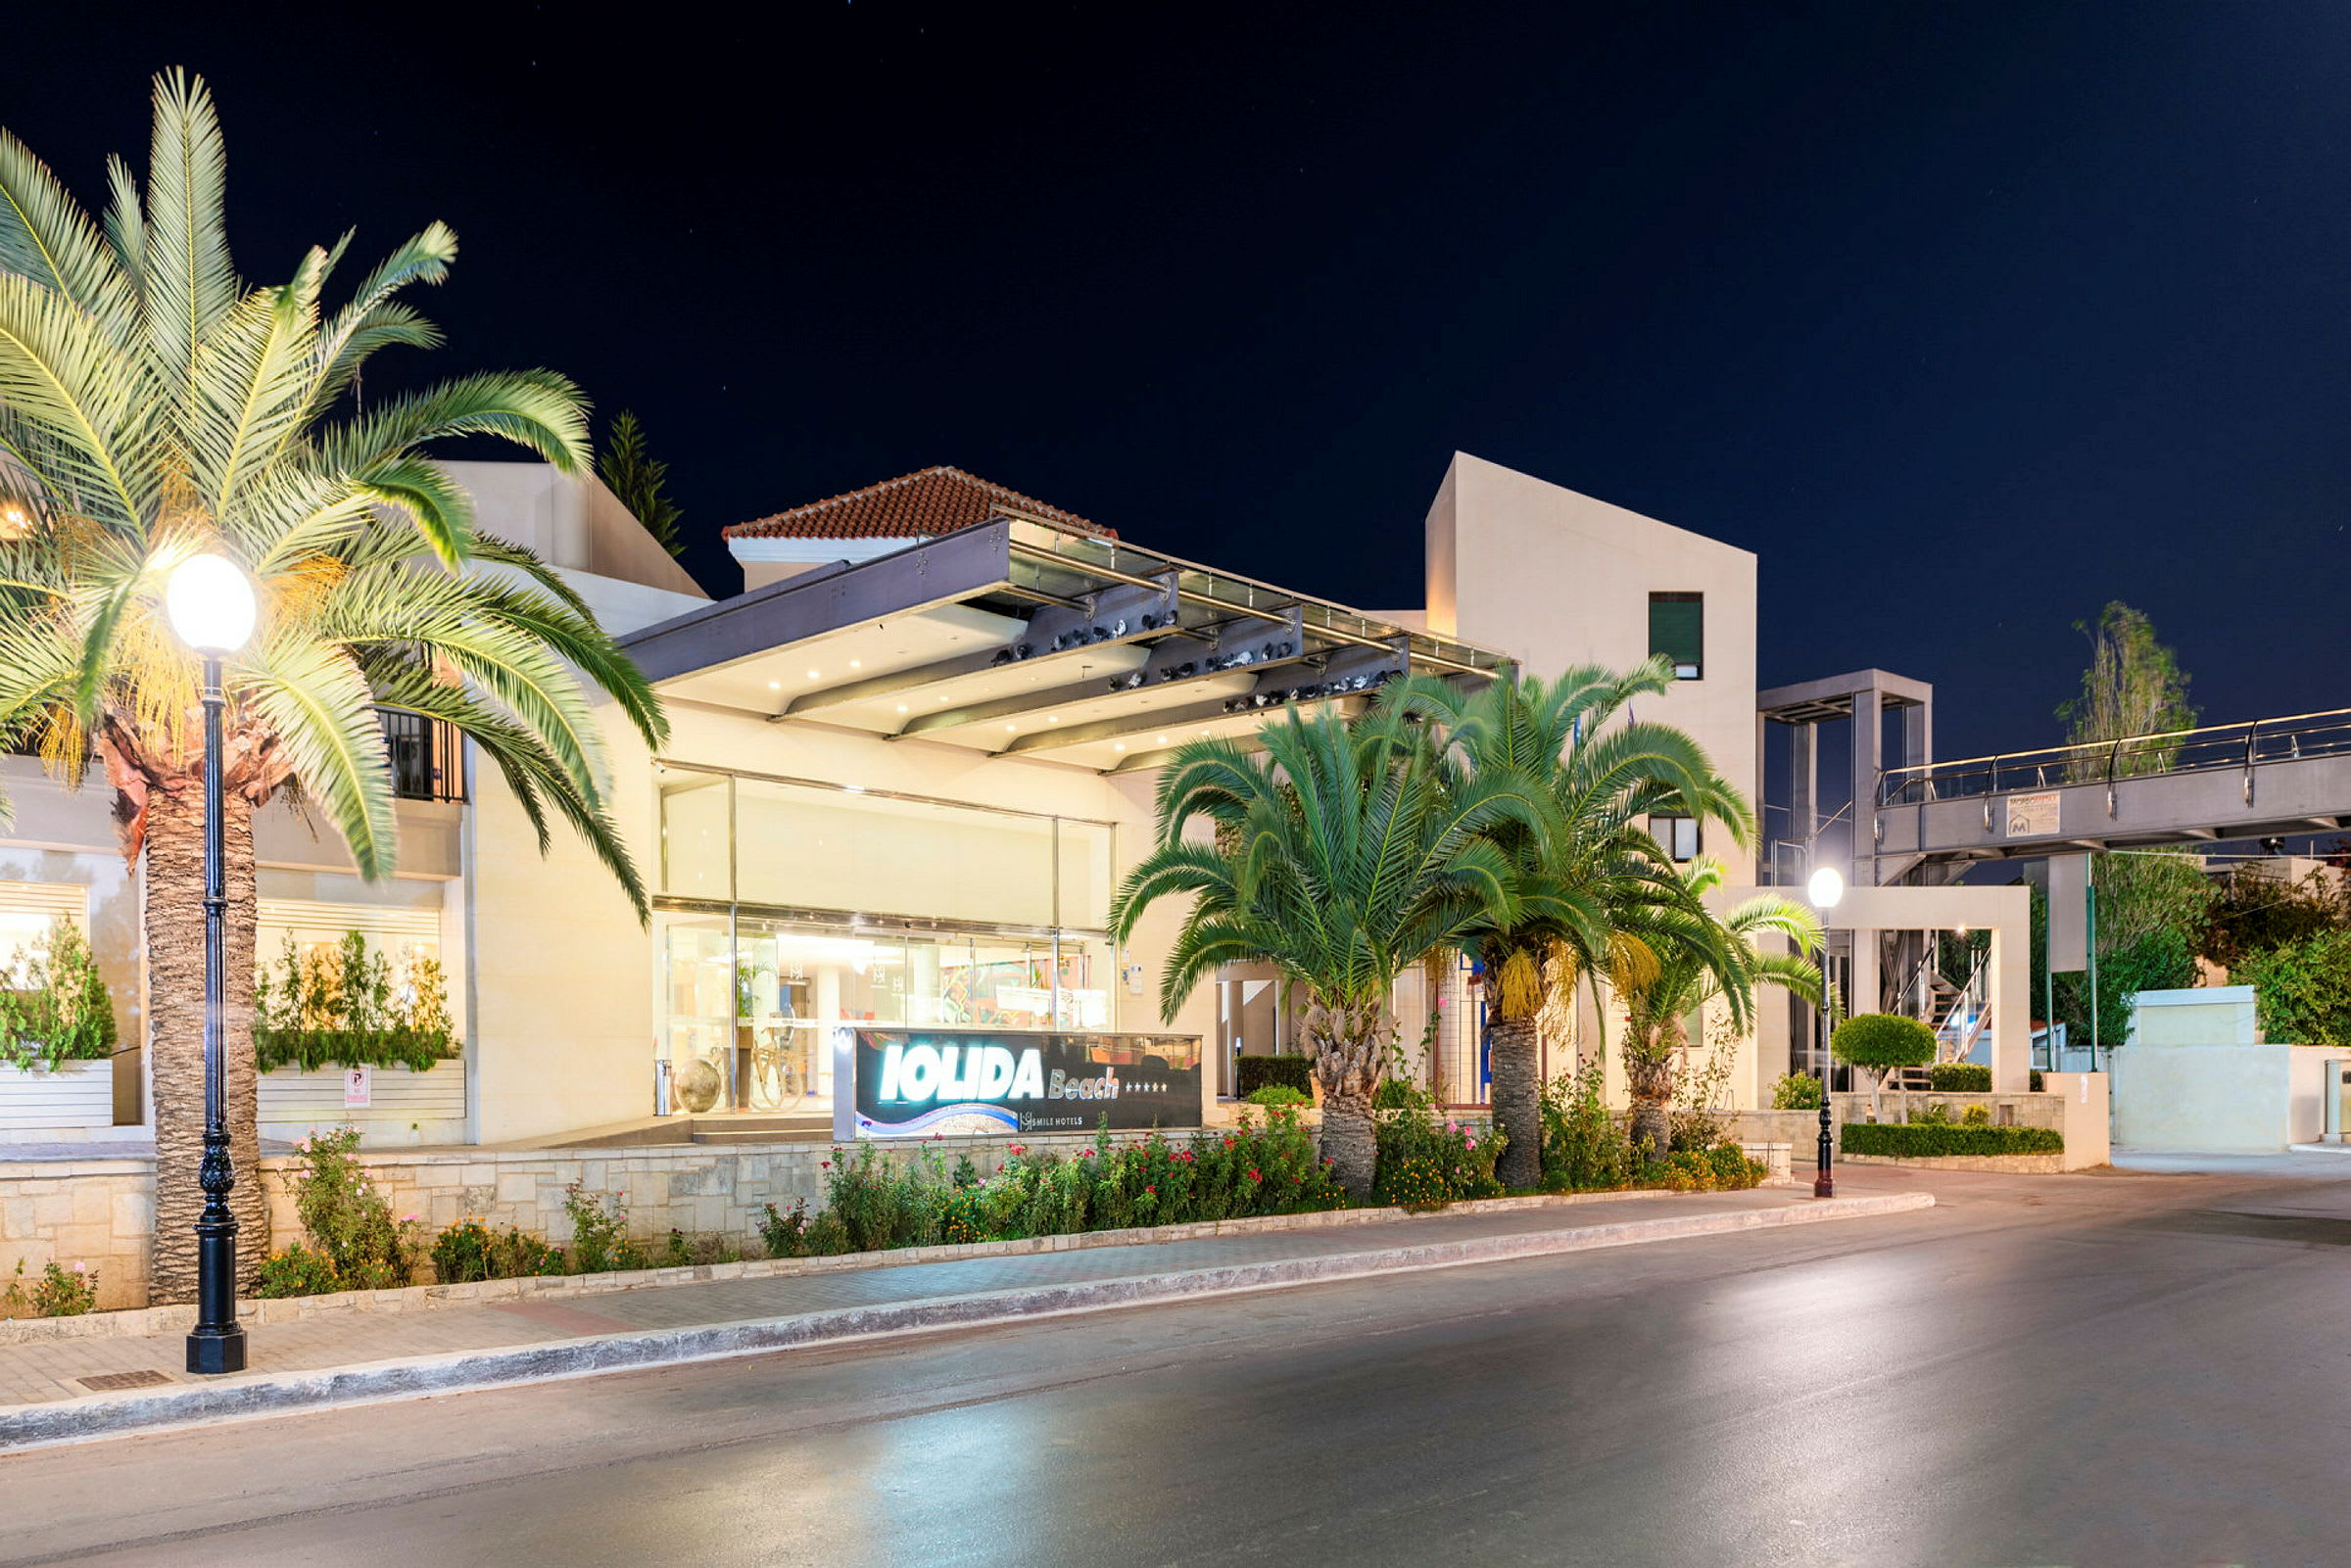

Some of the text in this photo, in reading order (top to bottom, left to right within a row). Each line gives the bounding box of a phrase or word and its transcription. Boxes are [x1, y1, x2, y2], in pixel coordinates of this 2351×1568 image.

[880, 1044, 1120, 1101] IOLIDA Beach
[1032, 1117, 1082, 1126] SMILE HOTELS
